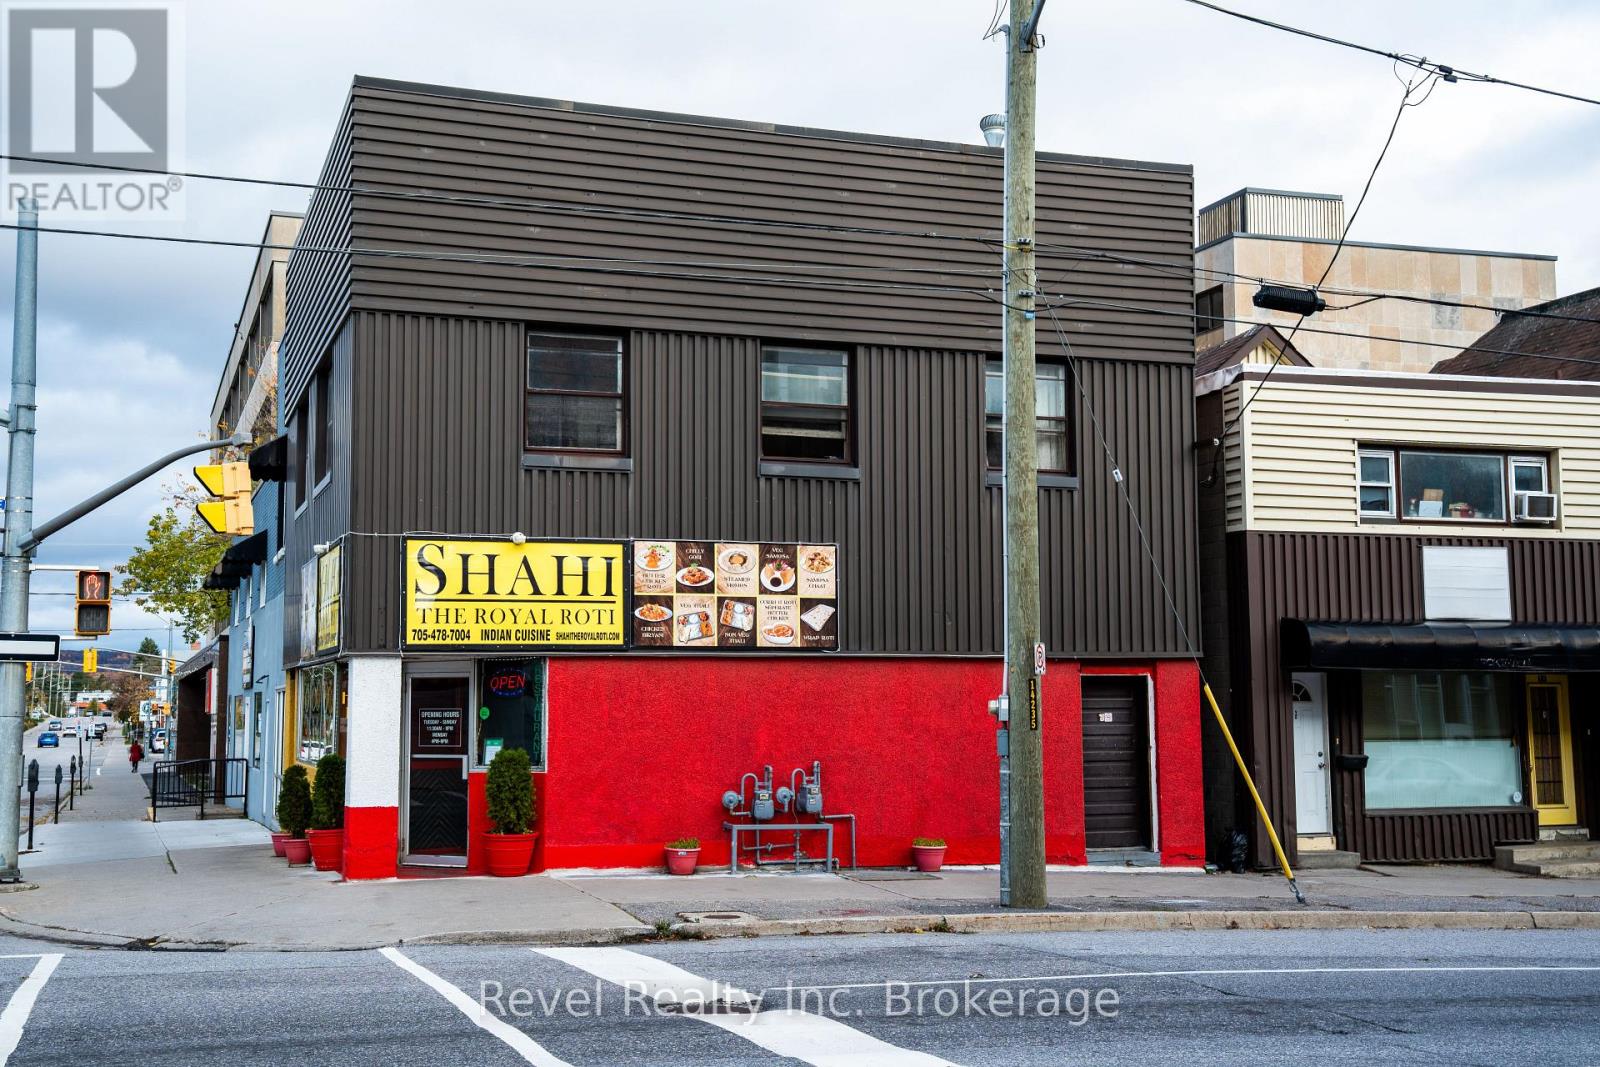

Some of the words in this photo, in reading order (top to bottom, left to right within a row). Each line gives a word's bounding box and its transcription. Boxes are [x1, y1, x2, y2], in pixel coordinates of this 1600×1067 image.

[415, 543, 617, 597] SHAHI
[416, 608, 467, 624] THE
[474, 608, 553, 625] ROYAL
[561, 609, 615, 625] ROTI
[412, 629, 471, 641] 705-478-7004
[480, 629, 512, 641] INDIAN
[515, 629, 551, 641] CUISINE
[555, 632, 620, 641] SHAHITHEROYALROTI.COM
[490, 671, 527, 689] OPEN
